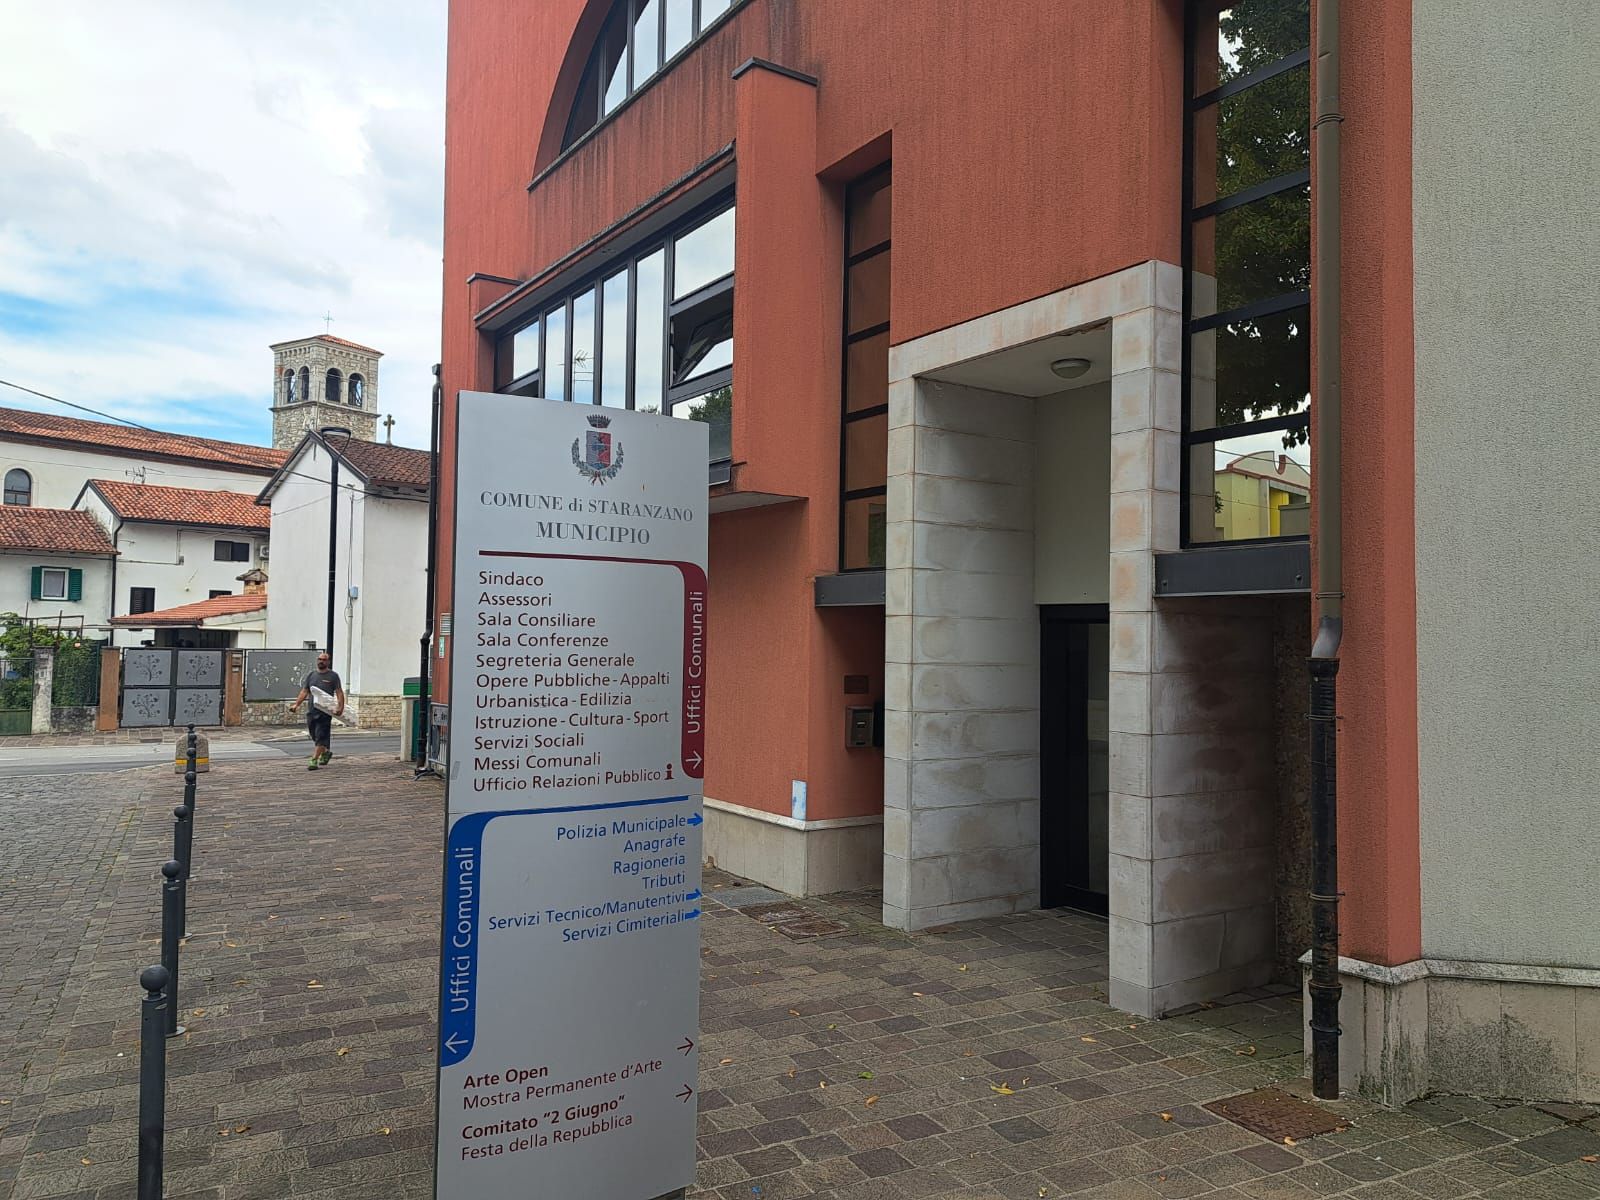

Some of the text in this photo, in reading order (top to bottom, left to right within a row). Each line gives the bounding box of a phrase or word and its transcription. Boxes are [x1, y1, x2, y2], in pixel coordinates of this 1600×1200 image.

[480, 491, 693, 522] COMUNE di STARANZANO
[536, 521, 650, 545] MUNICIPIO
[478, 570, 544, 587] Sindaco
[477, 591, 552, 607] Assessori
[477, 612, 596, 628] Sala Consiliare
[476, 632, 609, 648] Sala Conferenze
[476, 653, 635, 671] Segreteria Generale
[687, 591, 703, 734] Uffici Comunali
[476, 674, 529, 693] Opere
[474, 732, 584, 751] Servizi Sociali
[473, 752, 601, 771] Messi Comunali
[473, 778, 527, 792] Ufficio
[532, 772, 600, 790] Relazioni
[605, 769, 661, 785] Pubblico
[557, 814, 687, 841] Polizia Municipale
[623, 834, 686, 853] Anagrafe
[613, 853, 686, 877] Ragioneria
[642, 872, 685, 890] Tributi
[488, 892, 685, 930] Servizi Tecnico/Manutentivi
[450, 846, 474, 1013] Uffici Comunali
[562, 910, 685, 942] Servizi Cimiteriali
[463, 1066, 548, 1090] Arte Open
[463, 1059, 662, 1110] Mostra Permanente d'Arte
[461, 1116, 538, 1140] Comitato
[461, 1114, 633, 1161] Festa della Repubblica
